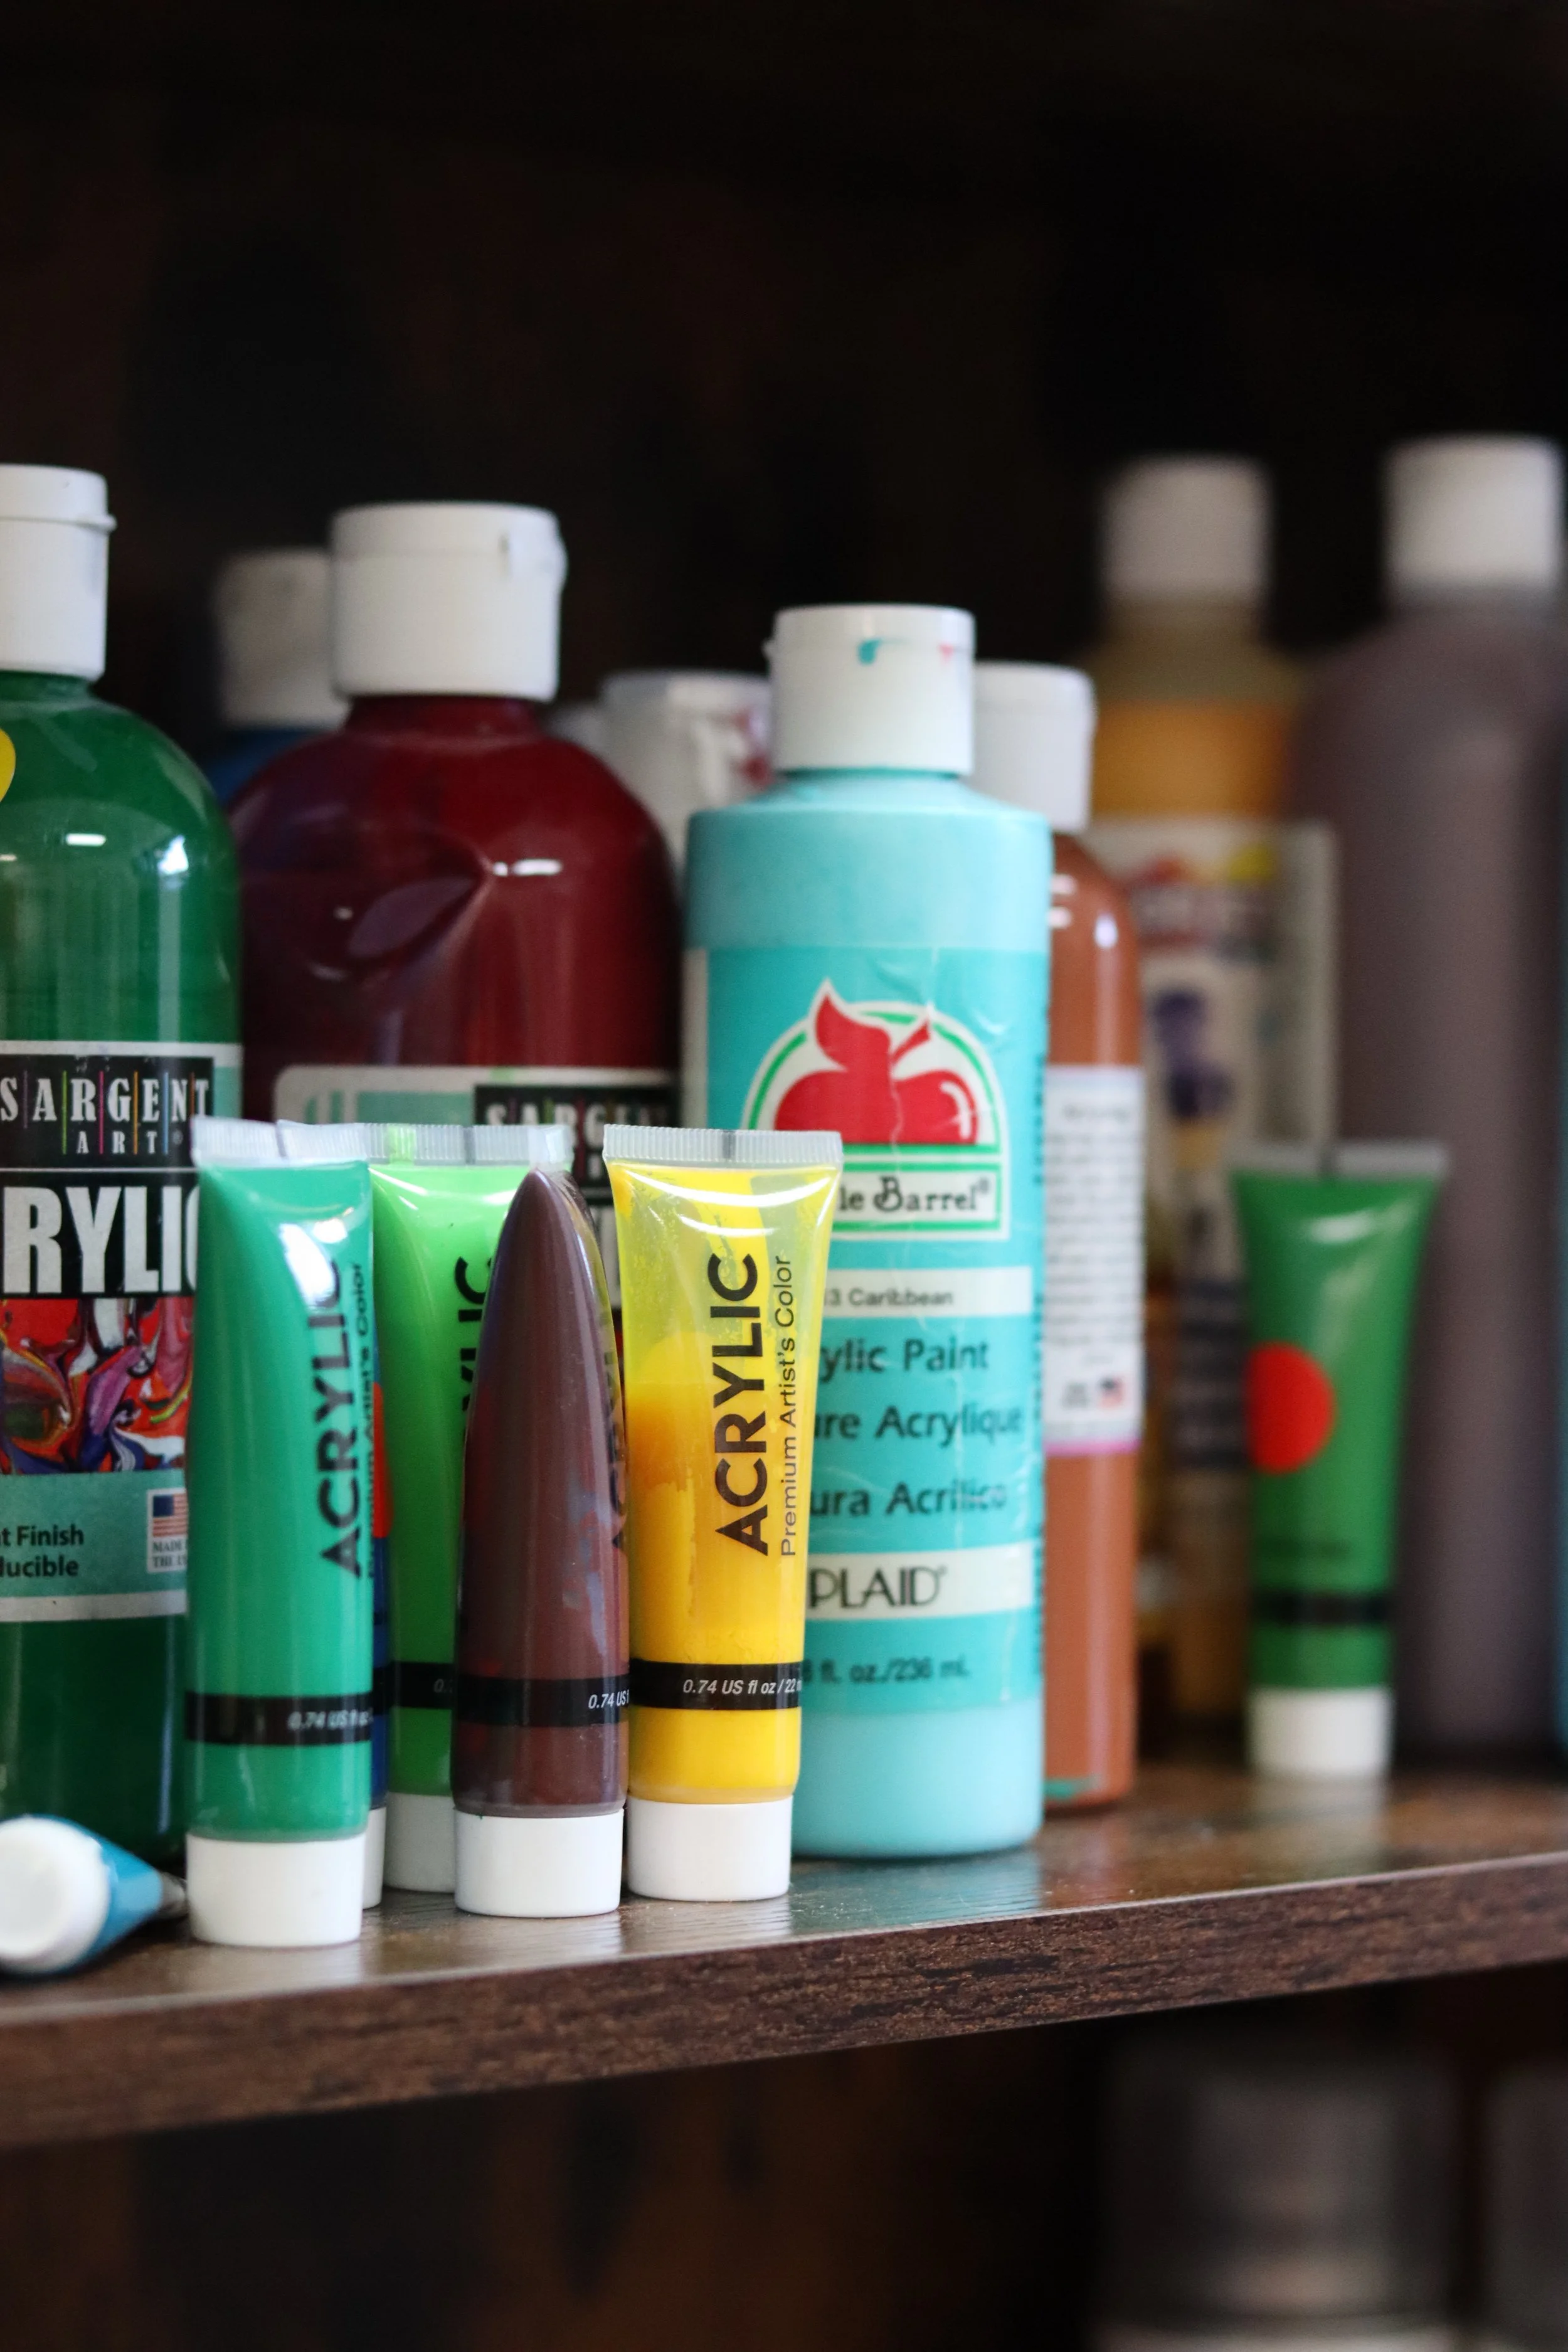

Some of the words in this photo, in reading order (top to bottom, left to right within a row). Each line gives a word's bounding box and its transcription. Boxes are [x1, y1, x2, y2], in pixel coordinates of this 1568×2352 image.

[0, 1077, 209, 1122] SARGENT
[77, 1131, 157, 1153] ART
[873, 1176, 977, 1211] Barrel
[4, 1187, 201, 1293] RYLI
[773, 1255, 795, 1327] Color
[849, 1288, 953, 1306] Caribbean
[904, 1336, 989, 1372] Paint
[777, 1338, 797, 1428] Artist's
[707, 1253, 768, 1557] ACRYLIC
[780, 1436, 797, 1556] Premium
[17, 1523, 85, 1547] Finish
[808, 1566, 941, 1609] PLAID
[588, 1692, 615, 1710] 0.74
[616, 1690, 627, 1707] US
[683, 1679, 717, 1694] 0.74
[722, 1679, 743, 1695] US
[747, 1680, 758, 1694] fl
[761, 1682, 776, 1694] oz
